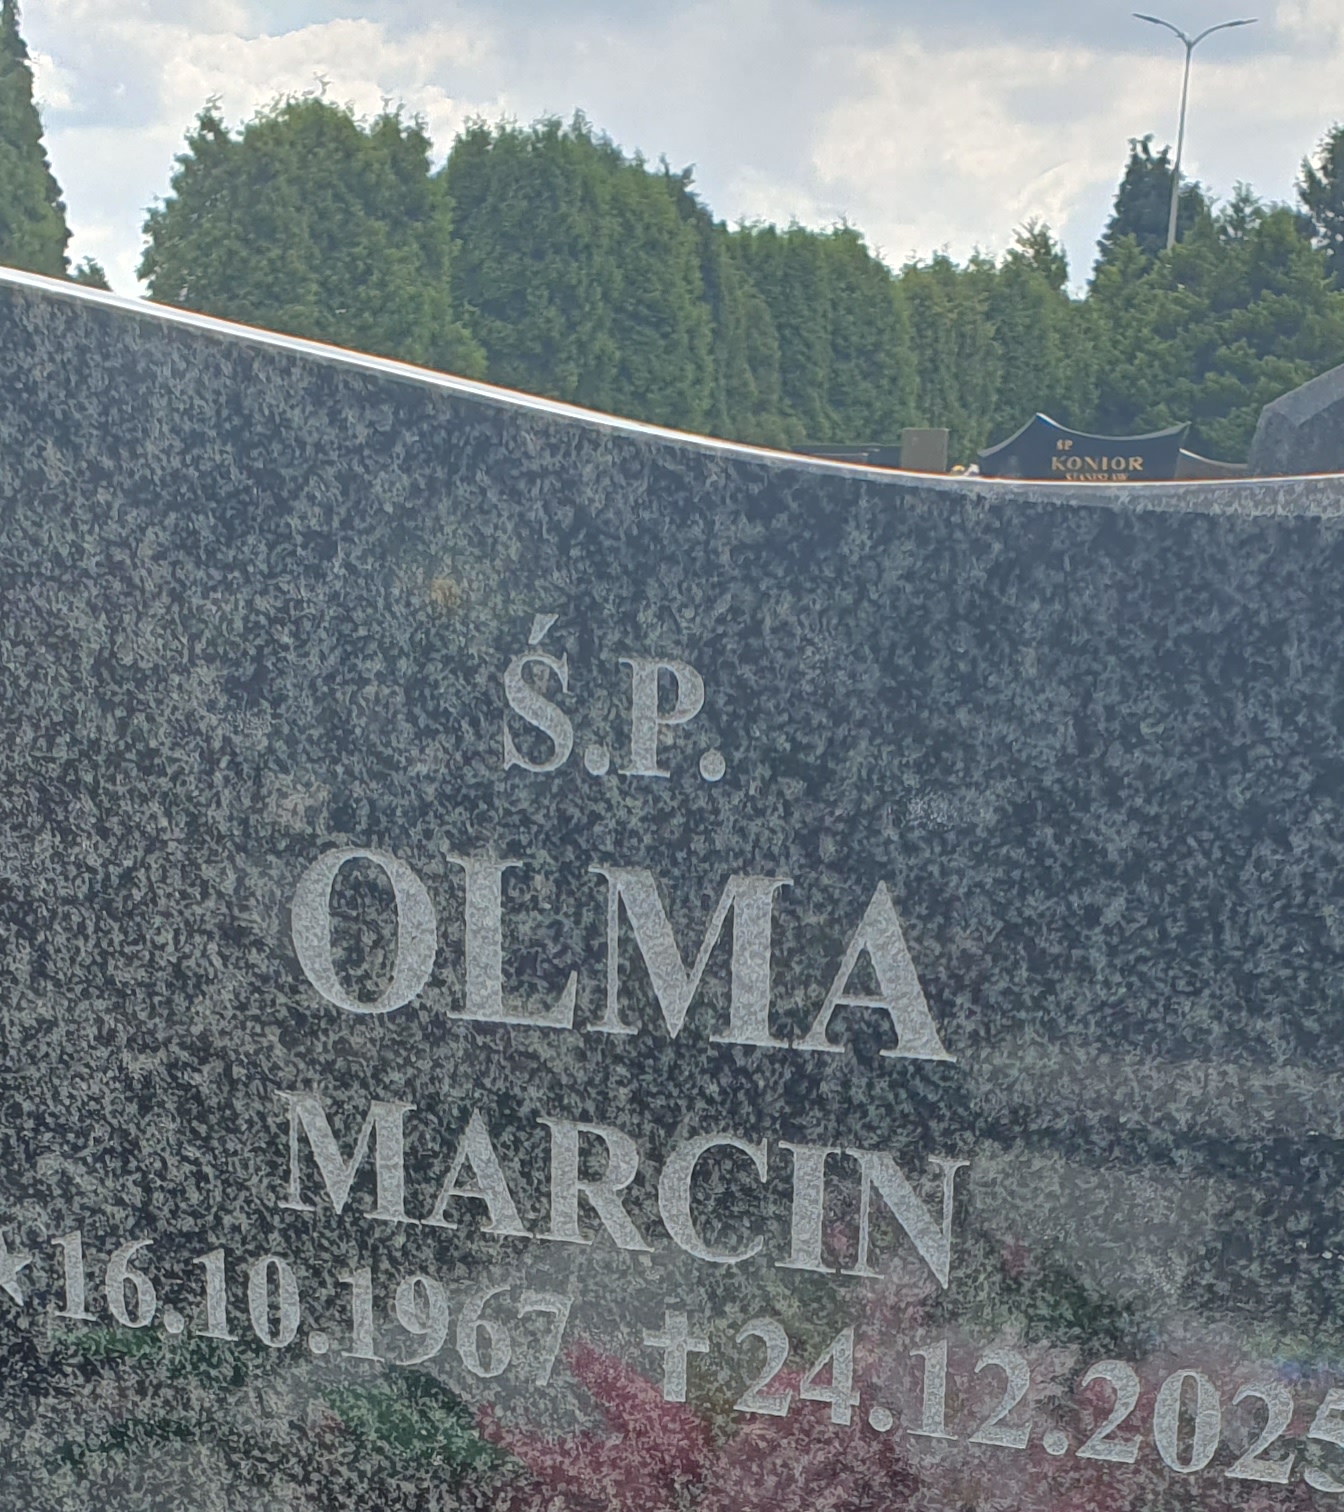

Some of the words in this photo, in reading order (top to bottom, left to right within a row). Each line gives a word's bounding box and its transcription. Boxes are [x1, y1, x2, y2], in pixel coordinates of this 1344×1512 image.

[1051, 456, 1143, 471] KONIOR
[501, 613, 728, 783] Ś.P.
[289, 848, 957, 1064] OLMA
[279, 1091, 971, 1290] MARCIN
[53, 1230, 573, 1386] 16.10.1967
